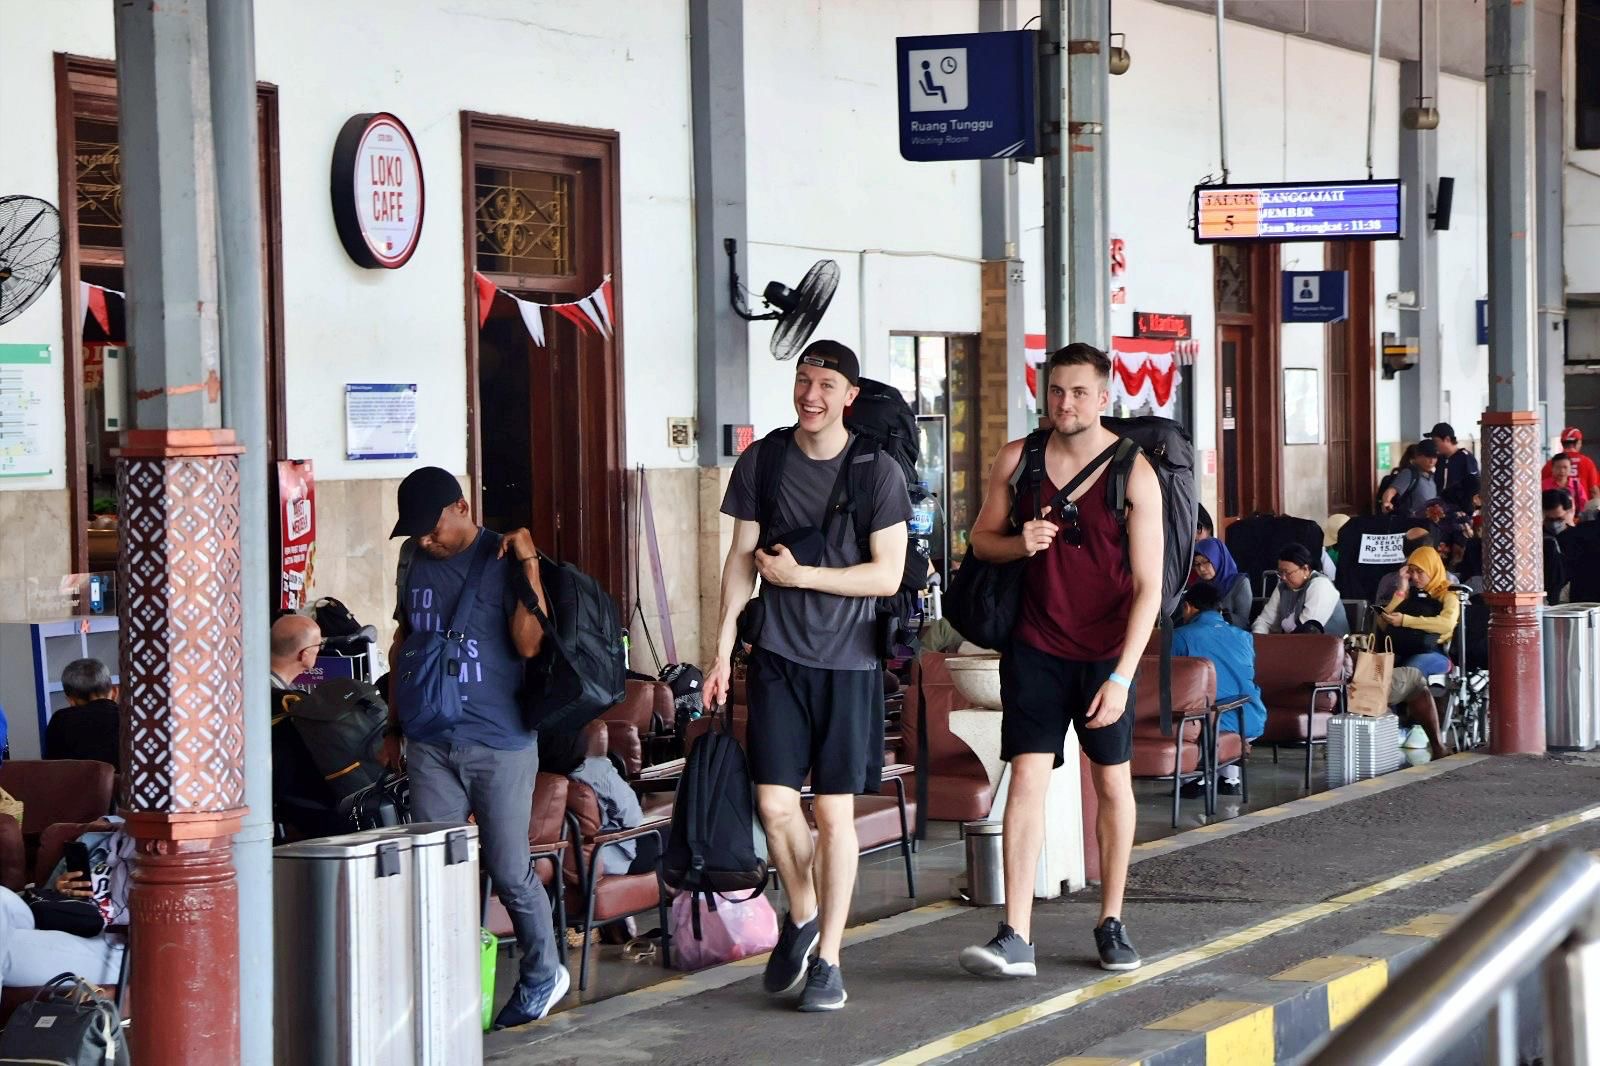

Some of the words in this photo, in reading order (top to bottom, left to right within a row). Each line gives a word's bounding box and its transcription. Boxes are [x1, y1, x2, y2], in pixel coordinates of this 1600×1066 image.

[911, 121, 947, 133] Ruang
[950, 119, 993, 132] Tunggu
[911, 137, 943, 146] Waiting
[946, 136, 969, 144] Room
[370, 155, 403, 187] LOKO
[372, 191, 404, 222] CAFE
[1204, 193, 1255, 206] JALUR
[1262, 207, 1315, 218] JEMBER
[1224, 215, 1234, 231] 5
[1262, 223, 1287, 233] Jam
[1289, 221, 1342, 234] Berangkat
[411, 588, 433, 609] TO
[411, 613, 444, 632] MIL
